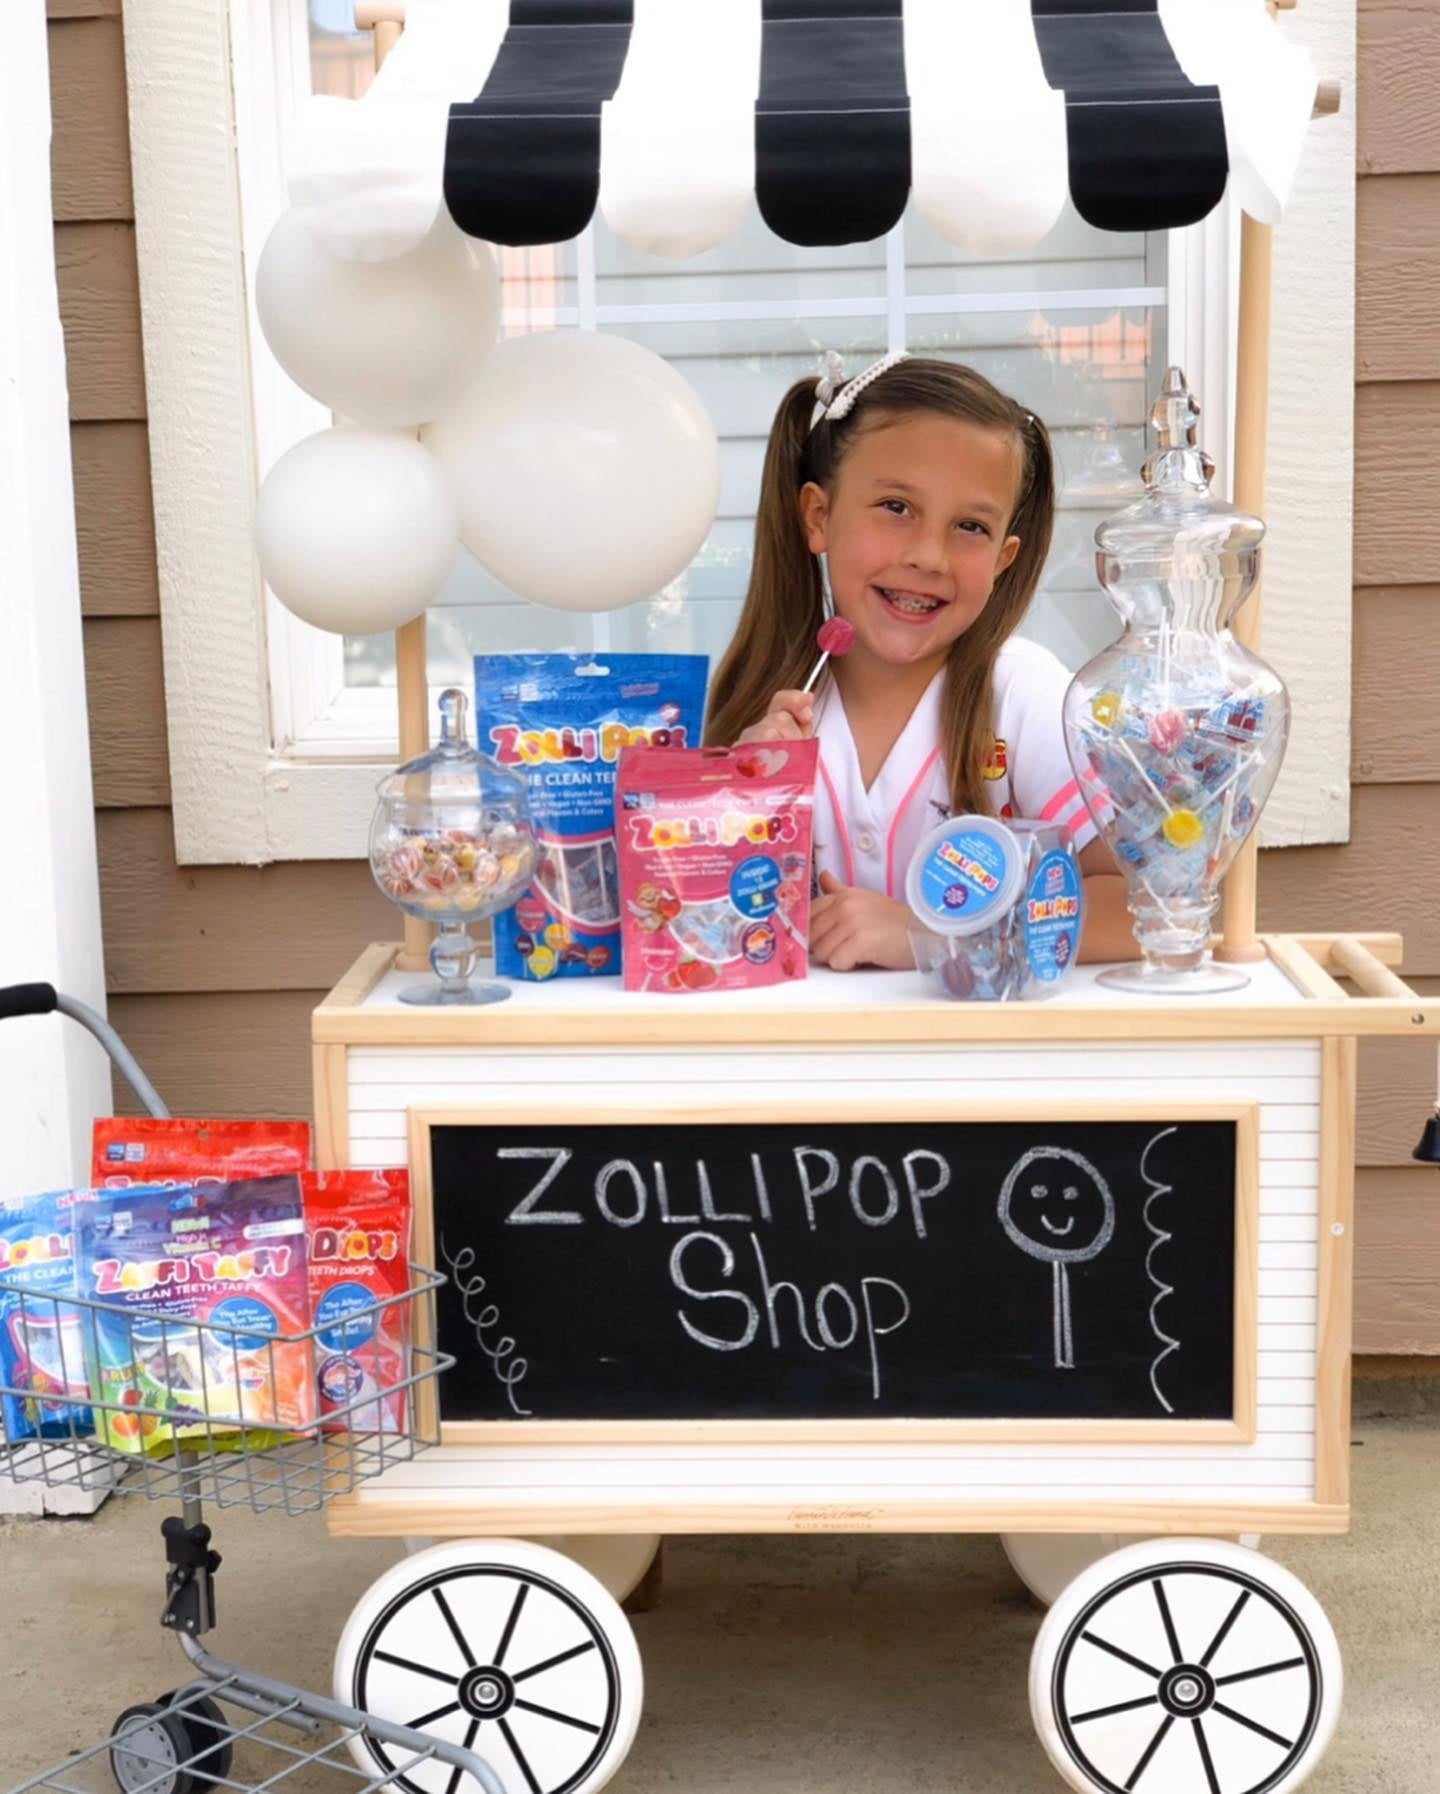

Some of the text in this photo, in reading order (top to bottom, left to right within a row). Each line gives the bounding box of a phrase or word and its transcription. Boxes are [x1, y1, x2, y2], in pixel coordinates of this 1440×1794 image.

[489, 724, 598, 767] ZOLLI
[545, 773, 592, 786] CLEAN
[629, 811, 798, 851] ZOLLI POPS
[92, 1245, 291, 1295] ZAFFI TAFFY
[339, 1265, 375, 1277] DROPS
[126, 1281, 263, 1301] CLEAN TEETH TAFFY
[670, 1231, 910, 1399] Shop
